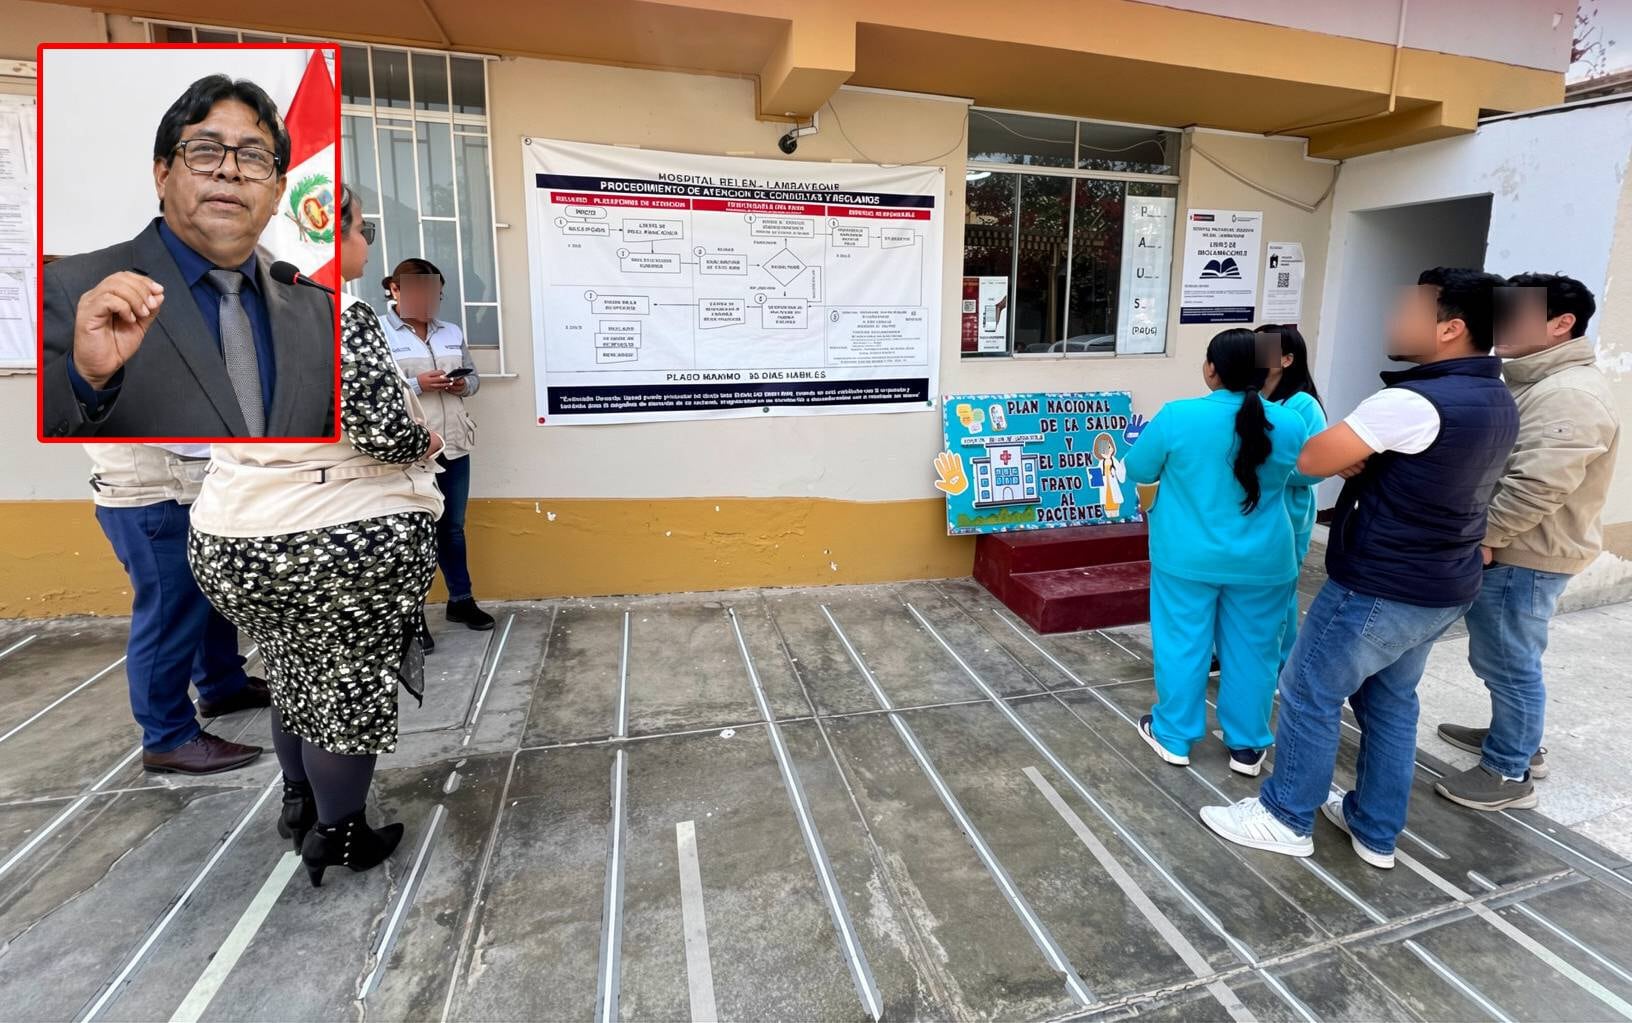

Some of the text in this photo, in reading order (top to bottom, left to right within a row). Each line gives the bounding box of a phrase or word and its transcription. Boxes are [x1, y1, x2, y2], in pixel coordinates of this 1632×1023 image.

[1007, 400, 1039, 414] PLAN
[1040, 418, 1057, 432] DE
[1065, 437, 1073, 451] Y
[1040, 455, 1053, 470] EL
[1041, 476, 1082, 492] TRATO
[1061, 492, 1075, 507] AL
